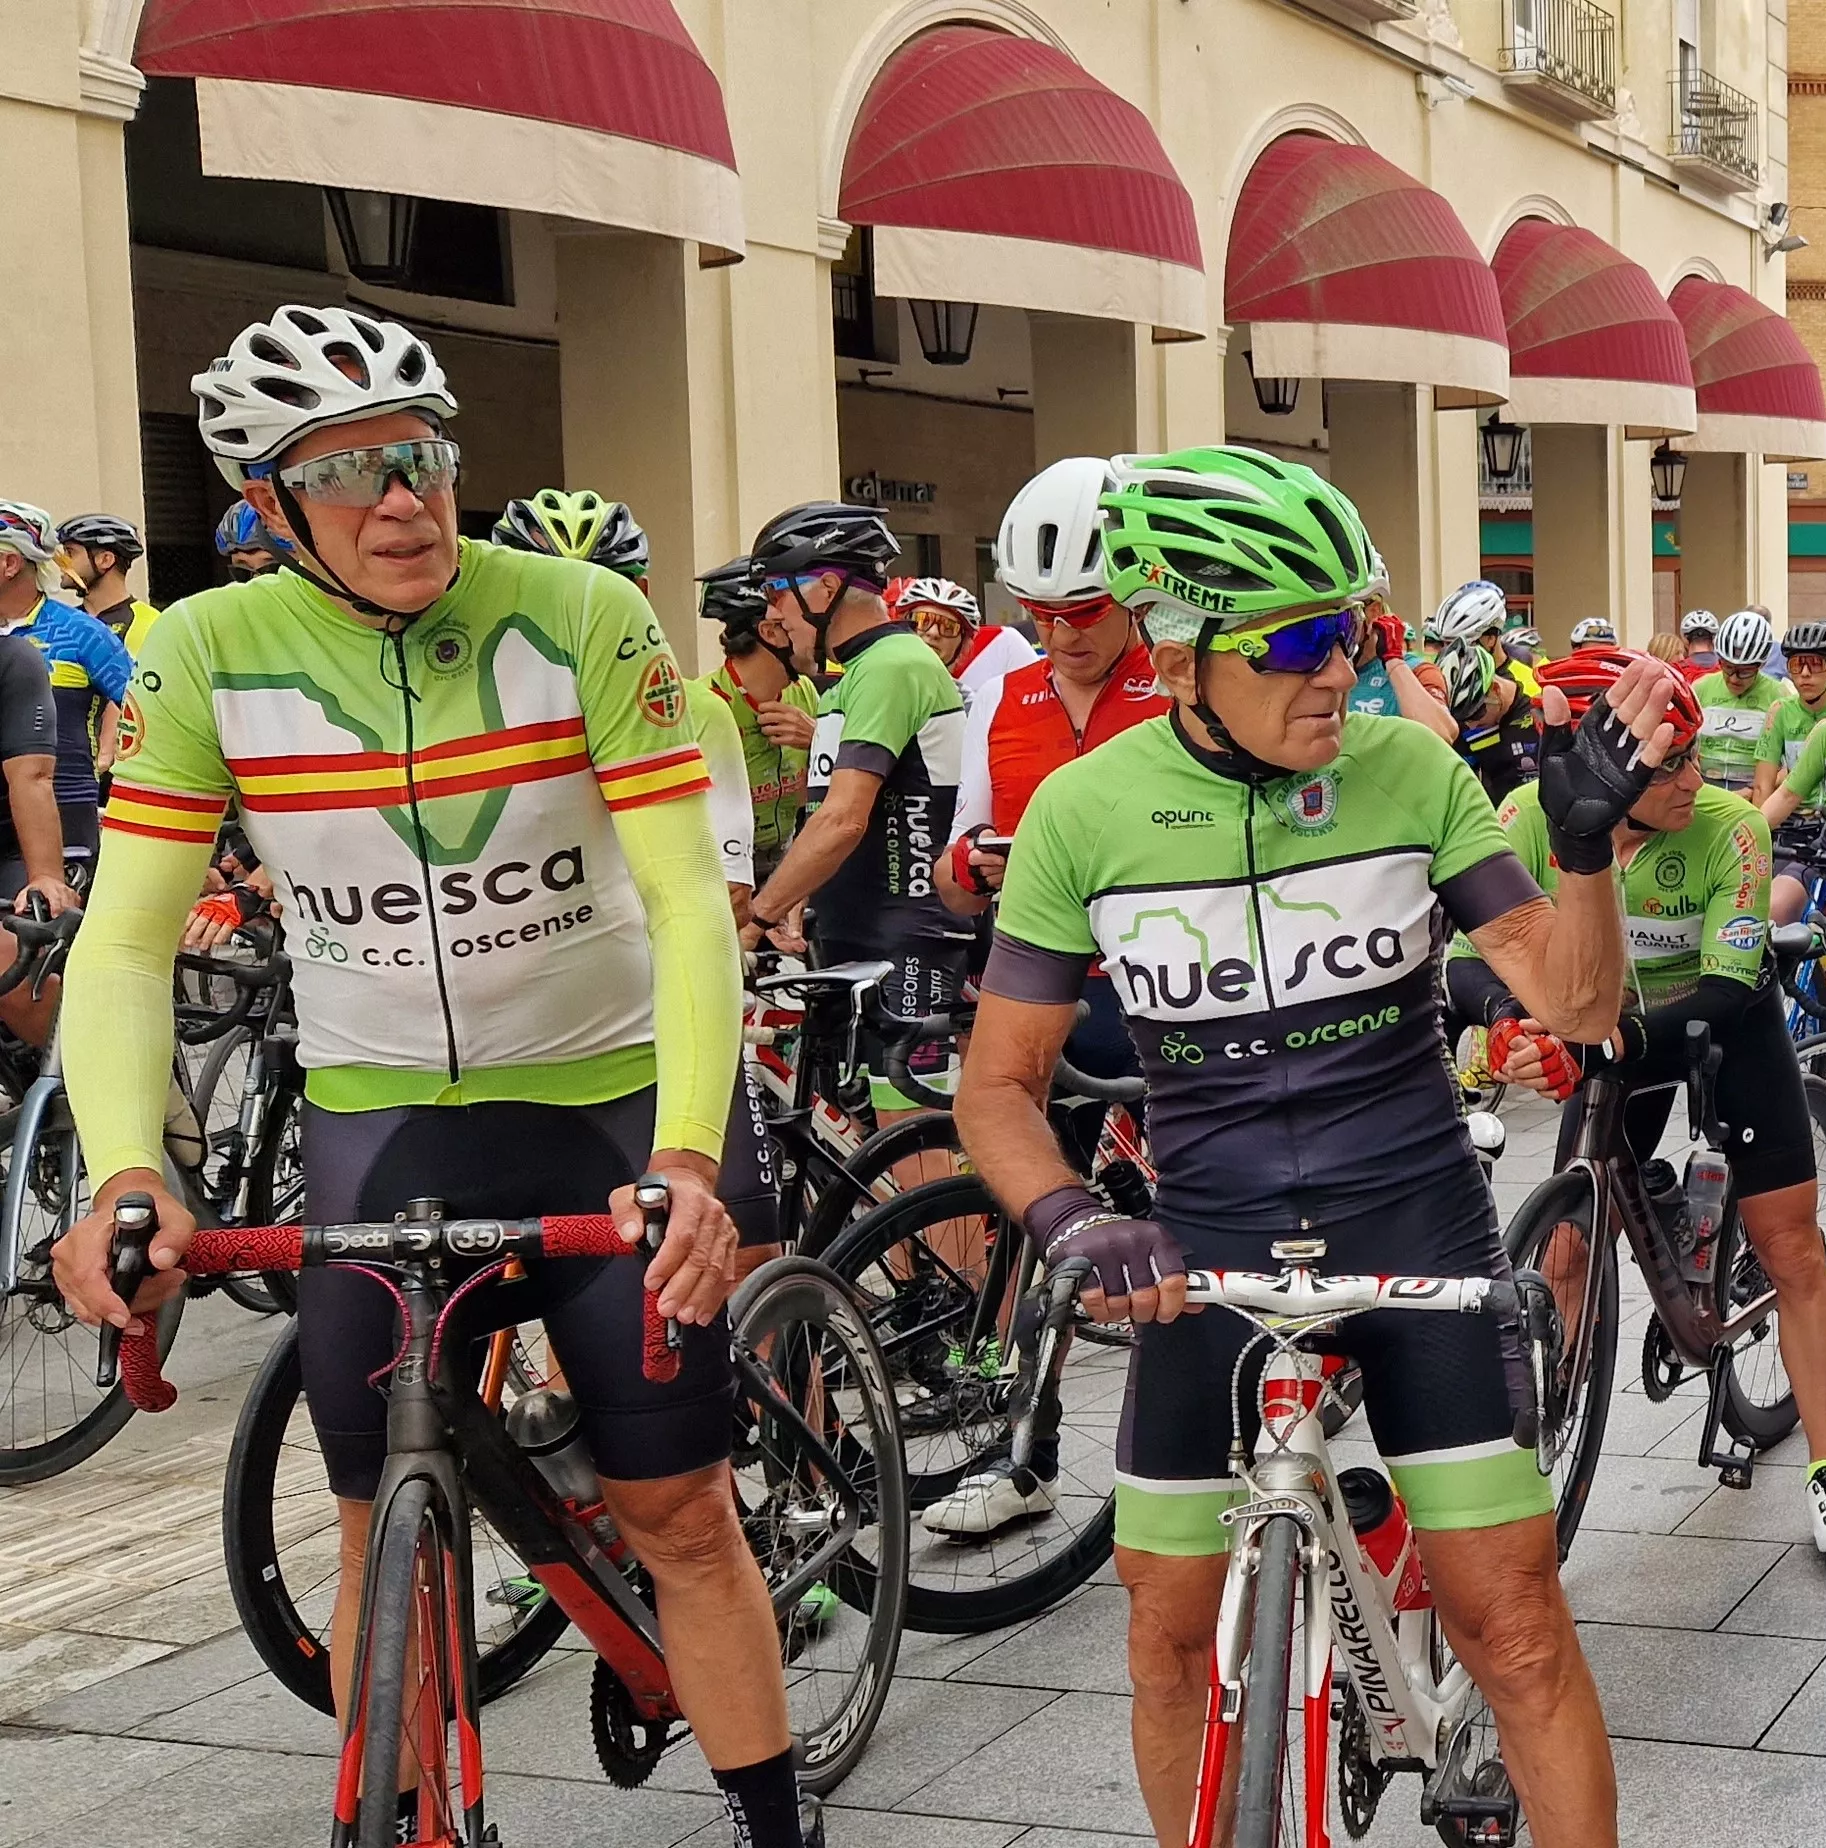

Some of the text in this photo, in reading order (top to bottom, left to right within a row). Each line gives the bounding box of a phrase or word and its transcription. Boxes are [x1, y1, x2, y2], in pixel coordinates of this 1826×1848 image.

[1139, 557, 1237, 612] EXTREME
[904, 795, 933, 898] huesca
[283, 845, 586, 925] huesca
[362, 903, 594, 967] c.c. oscense
[1119, 927, 1405, 1009] huesca
[1223, 1004, 1401, 1061] c.c. oscense
[453, 1226, 496, 1249] 35
[1327, 1550, 1396, 1713] PINARELLO
